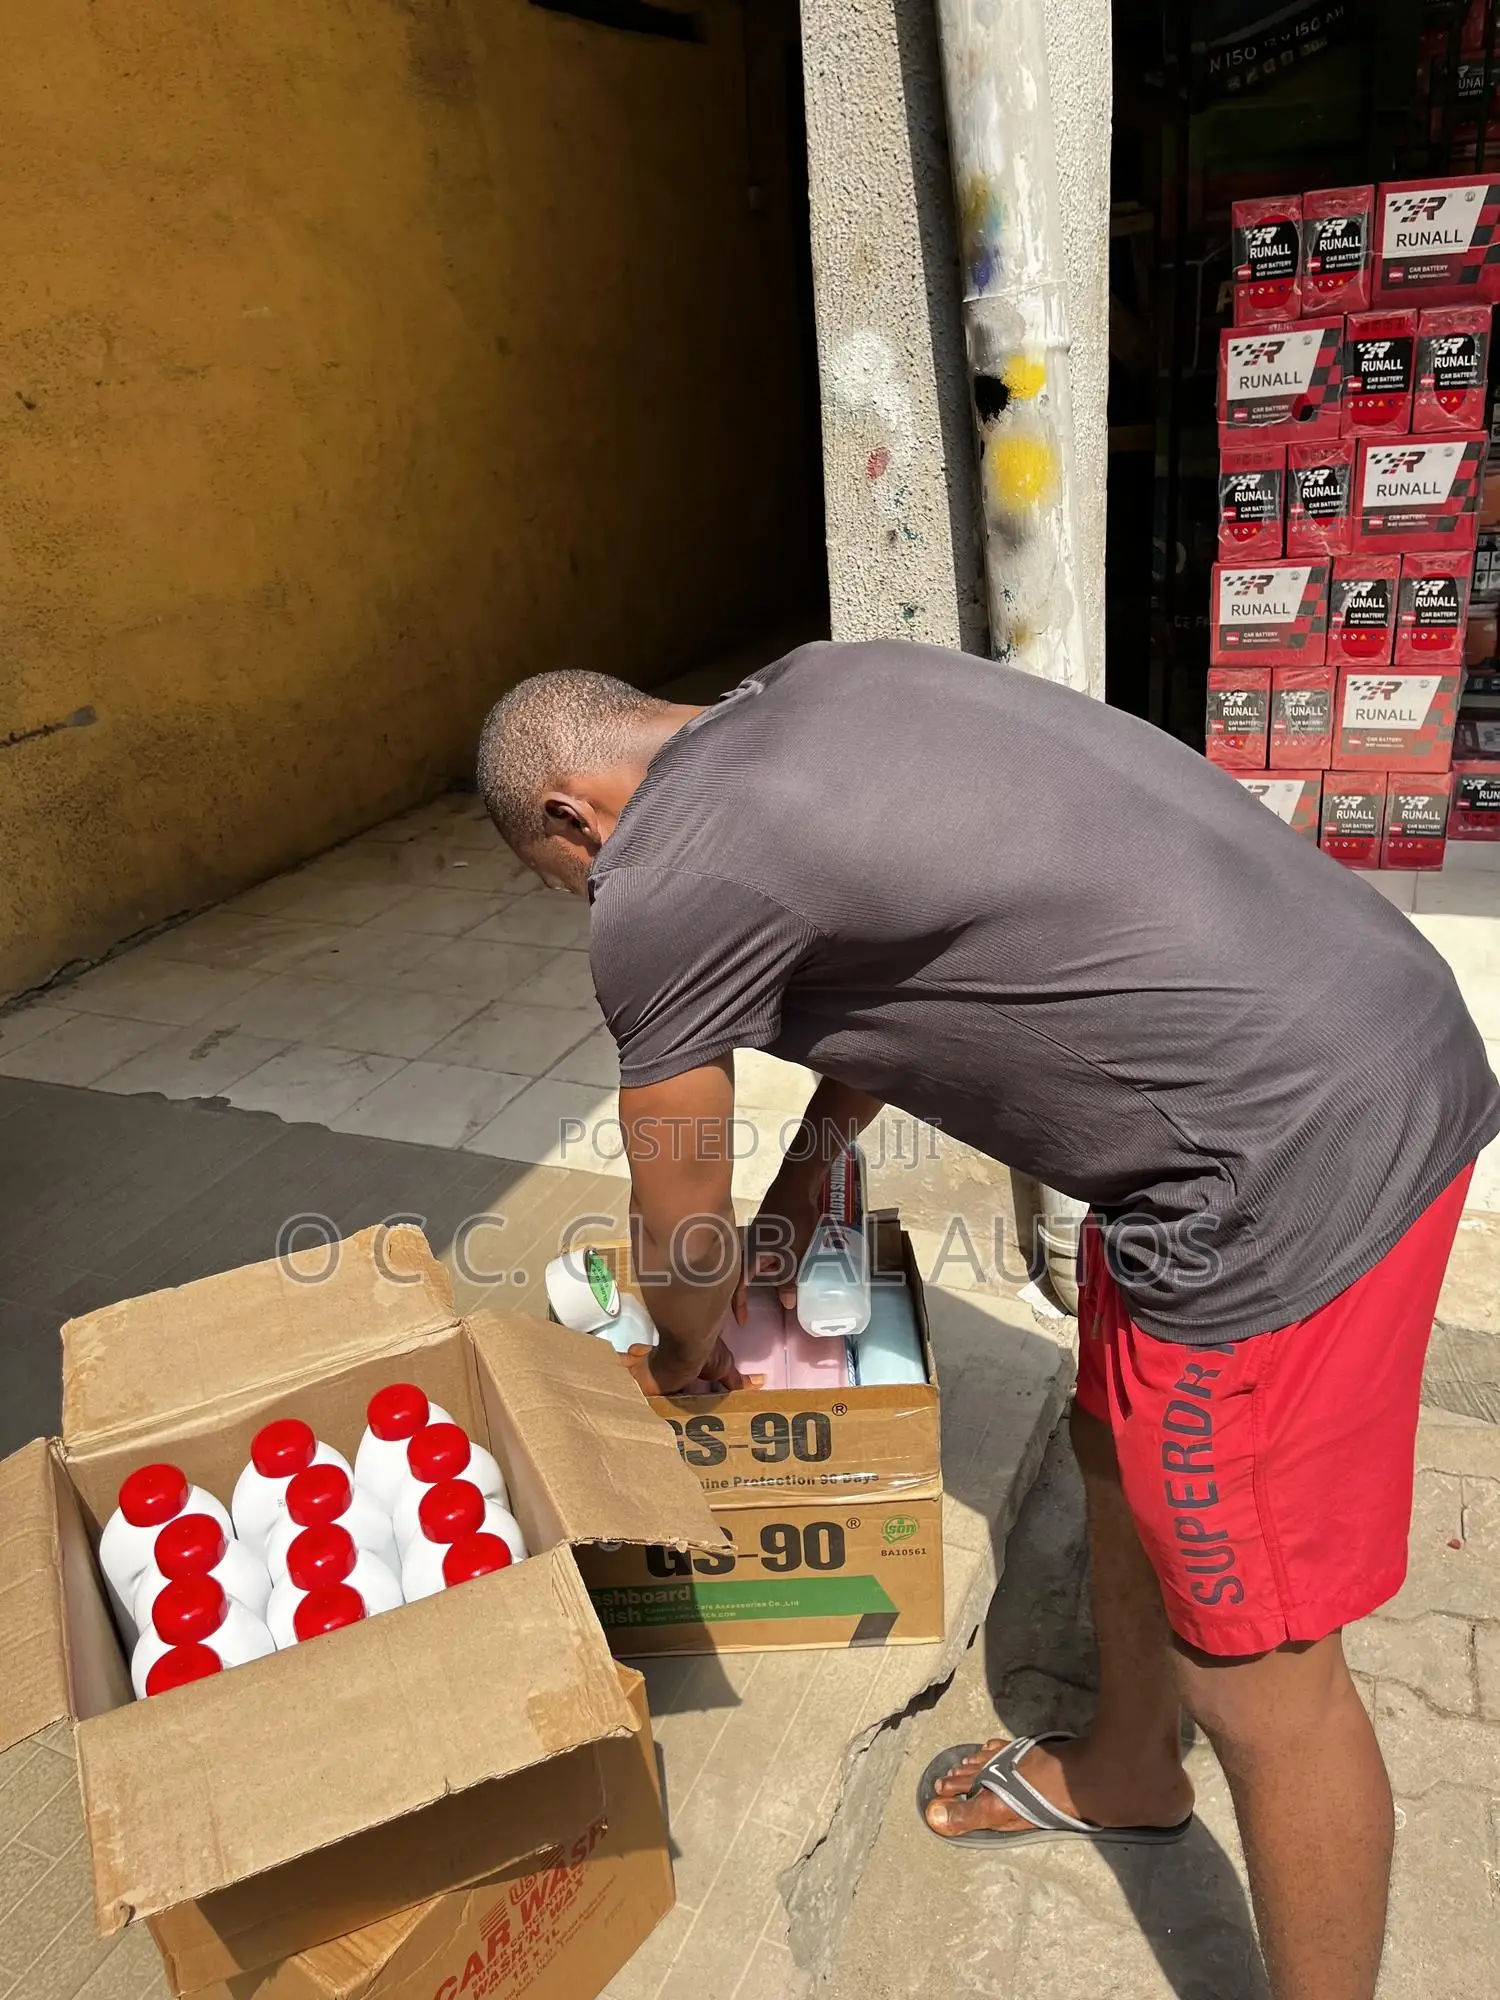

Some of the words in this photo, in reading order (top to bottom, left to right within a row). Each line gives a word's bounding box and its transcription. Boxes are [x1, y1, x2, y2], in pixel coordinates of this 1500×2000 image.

[1458, 76, 1484, 89] UNA
[1320, 235, 1361, 252] RUNALL
[1396, 229, 1463, 248] RUNALL
[1250, 243, 1291, 259] RUNALL
[1361, 359, 1403, 372] RUNALL
[1434, 355, 1478, 368] RUNALL
[1240, 371, 1302, 390] RUNALL
[1302, 485, 1343, 498] RUNALL
[1376, 482, 1442, 496] RUNALL
[1234, 490, 1274, 502] RUNALL
[1416, 596, 1457, 607] RUNALL
[1231, 603, 1290, 616] RUNALL
[1223, 706, 1260, 716] RUNALL
[1356, 708, 1417, 721] RUNALL
[1336, 810, 1374, 820] RUNALL
[1402, 810, 1440, 820] RUNALL
[1161, 1342, 1245, 1606] SUPERDR
[733, 1474, 815, 1488] Protection
[881, 1548, 927, 1557] BA10561
[433, 1917, 511, 2000] CAR
